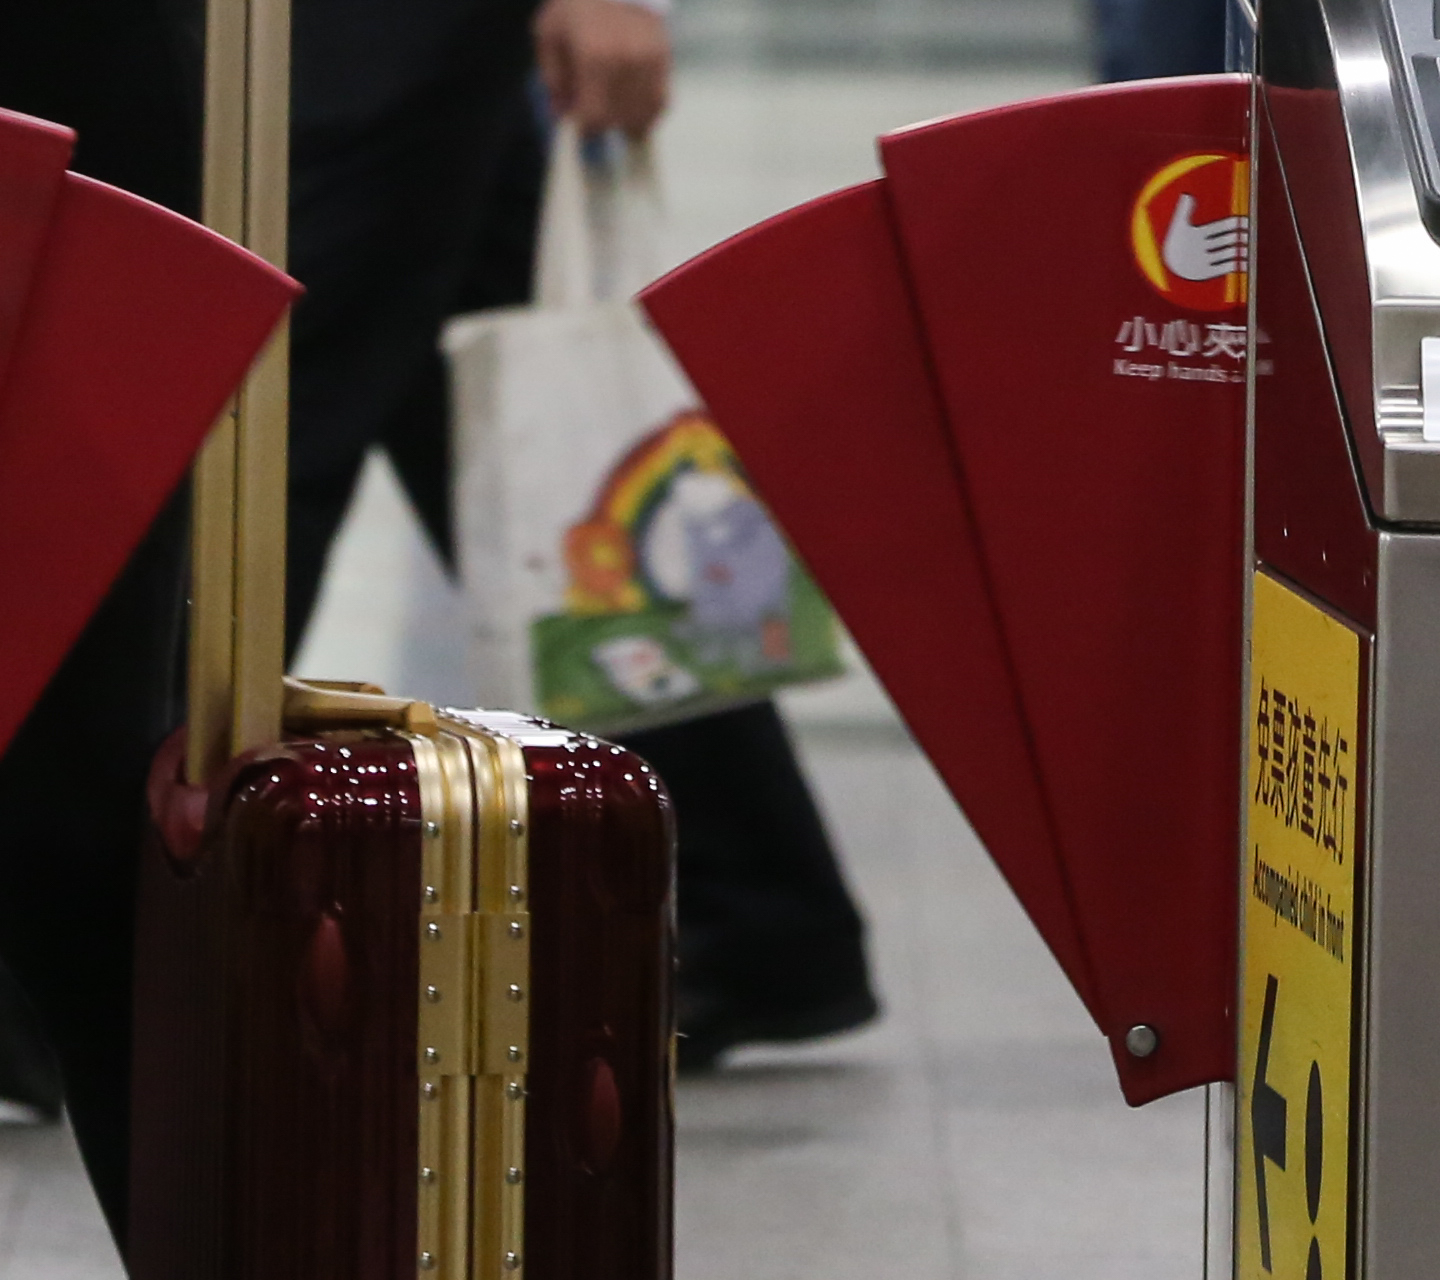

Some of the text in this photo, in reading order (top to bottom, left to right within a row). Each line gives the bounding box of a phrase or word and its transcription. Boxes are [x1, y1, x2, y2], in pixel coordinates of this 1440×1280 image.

[1113, 359, 1163, 381] Keep
[1167, 360, 1230, 383] hands
[1255, 676, 1348, 866] 免票孩童先行
[1252, 843, 1299, 929] Accompanied
